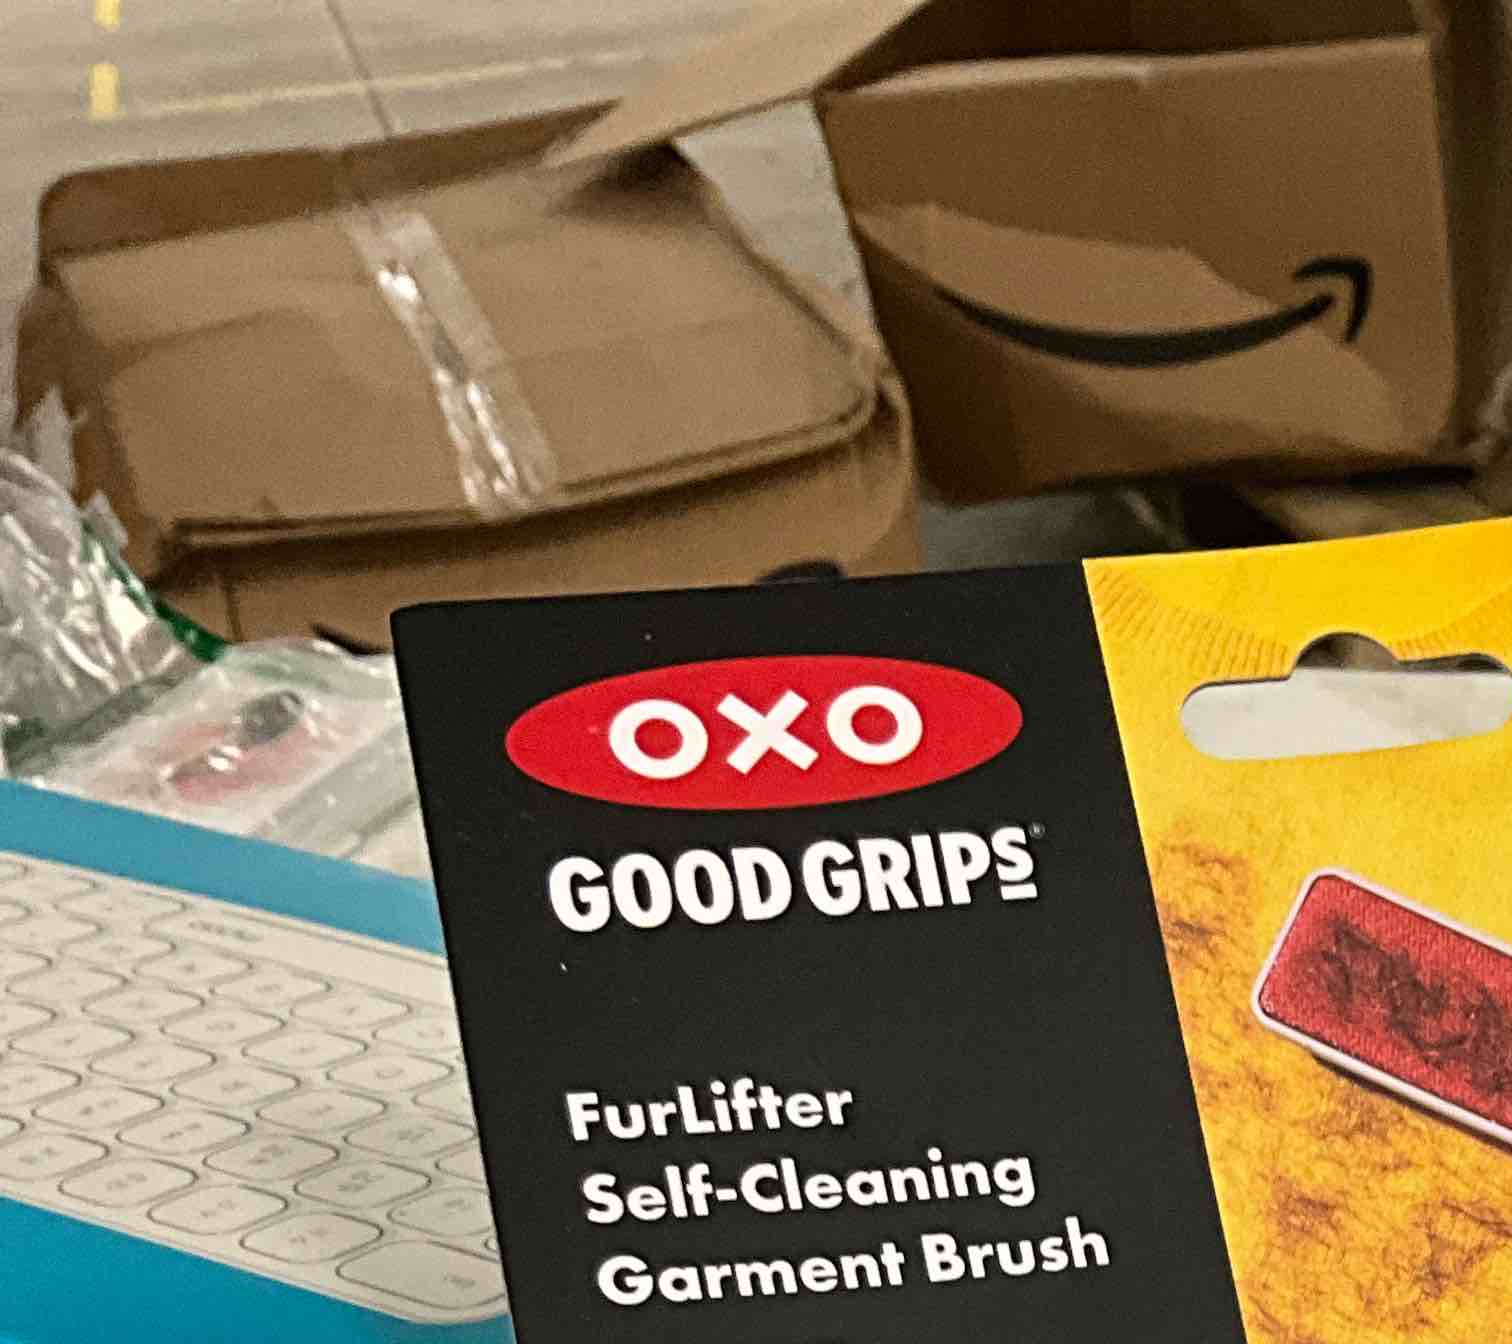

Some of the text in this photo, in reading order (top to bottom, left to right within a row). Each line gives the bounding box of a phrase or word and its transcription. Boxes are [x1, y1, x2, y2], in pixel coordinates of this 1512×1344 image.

[608, 685, 923, 780] OXO
[550, 846, 792, 932] GOOD
[565, 1077, 854, 1142] FurLifter
[581, 1147, 1036, 1224] Self-Cleaning
[597, 1216, 1110, 1306] Garment Brush
